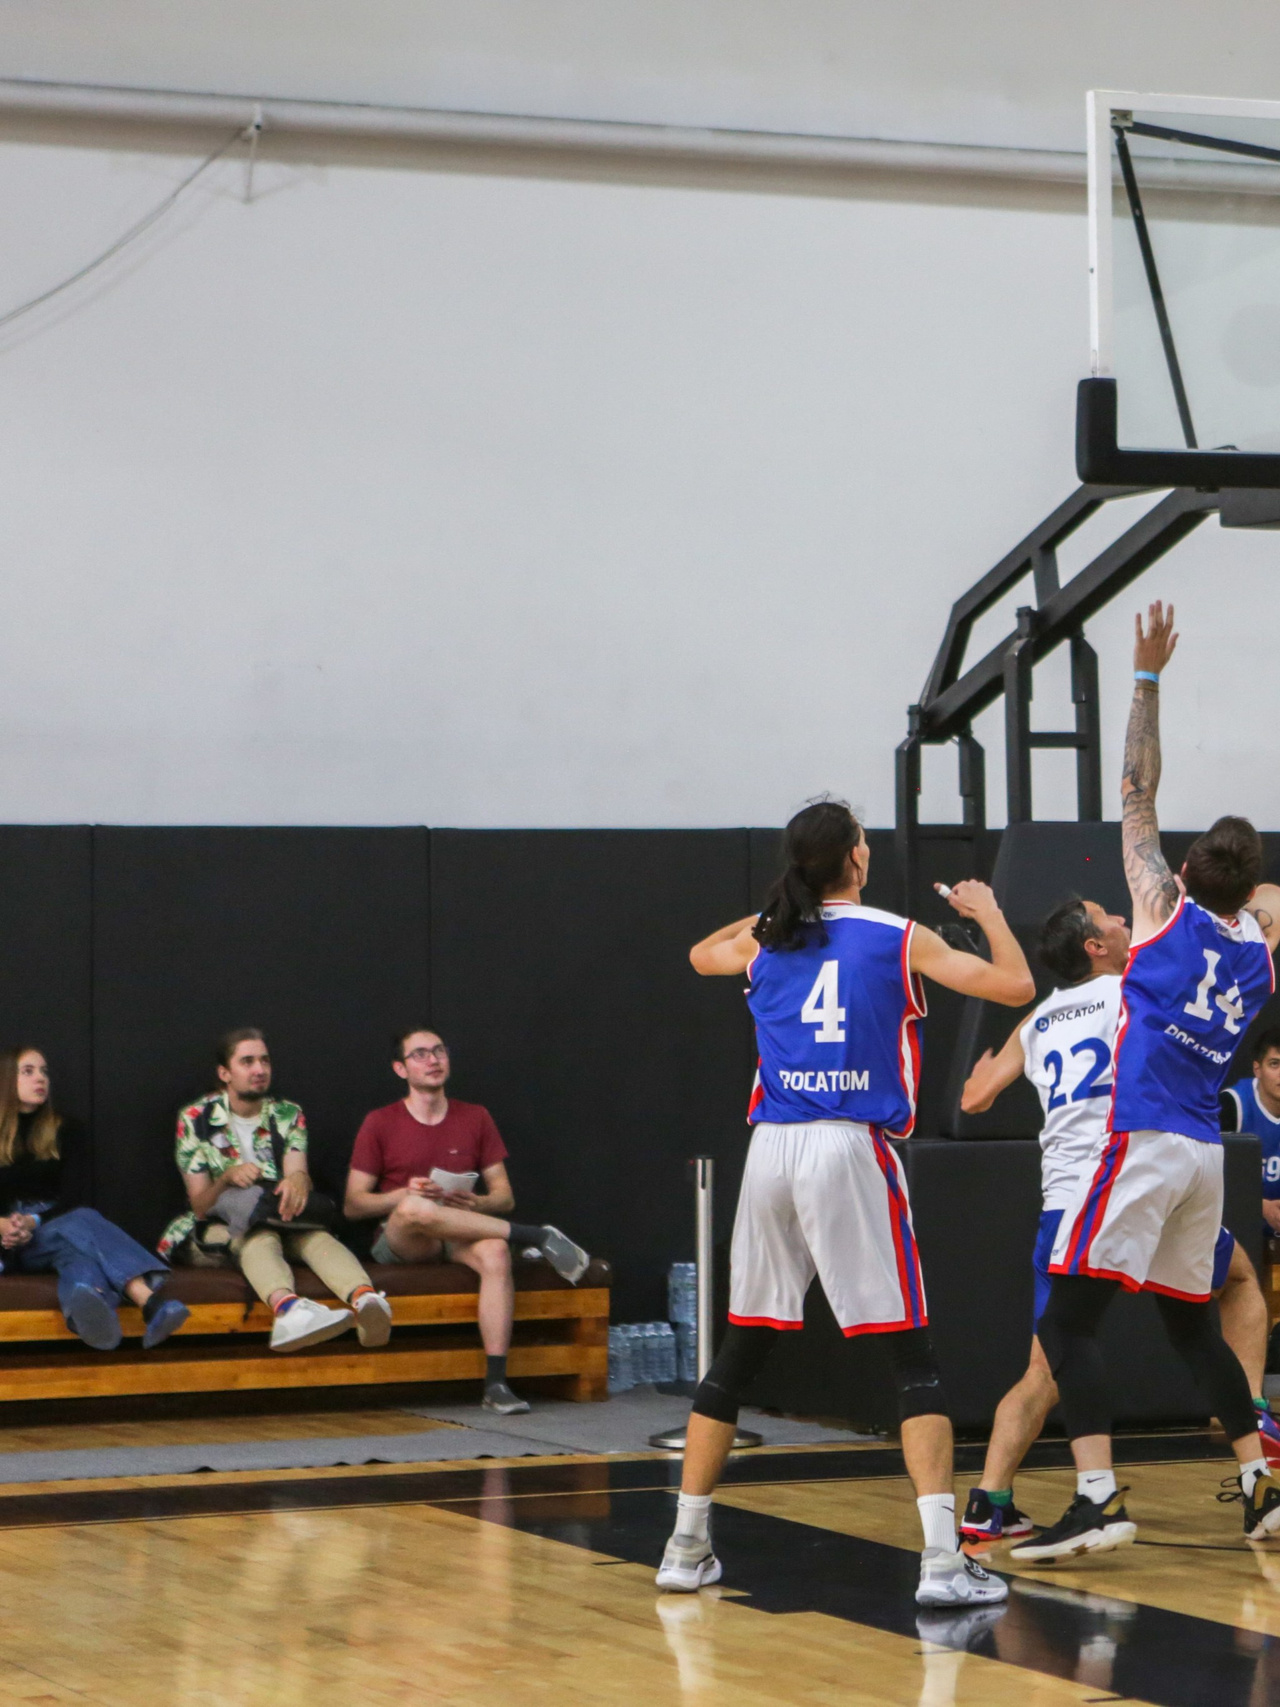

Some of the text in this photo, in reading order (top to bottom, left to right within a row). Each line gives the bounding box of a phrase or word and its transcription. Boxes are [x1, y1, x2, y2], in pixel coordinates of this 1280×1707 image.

[801, 960, 846, 1043] 4
[1051, 1000, 1105, 1025] РОСАТОМ
[1183, 948, 1245, 1035] 14
[778, 1069, 870, 1093] РОСАТОМ
[1043, 1036, 1113, 1115] 22
